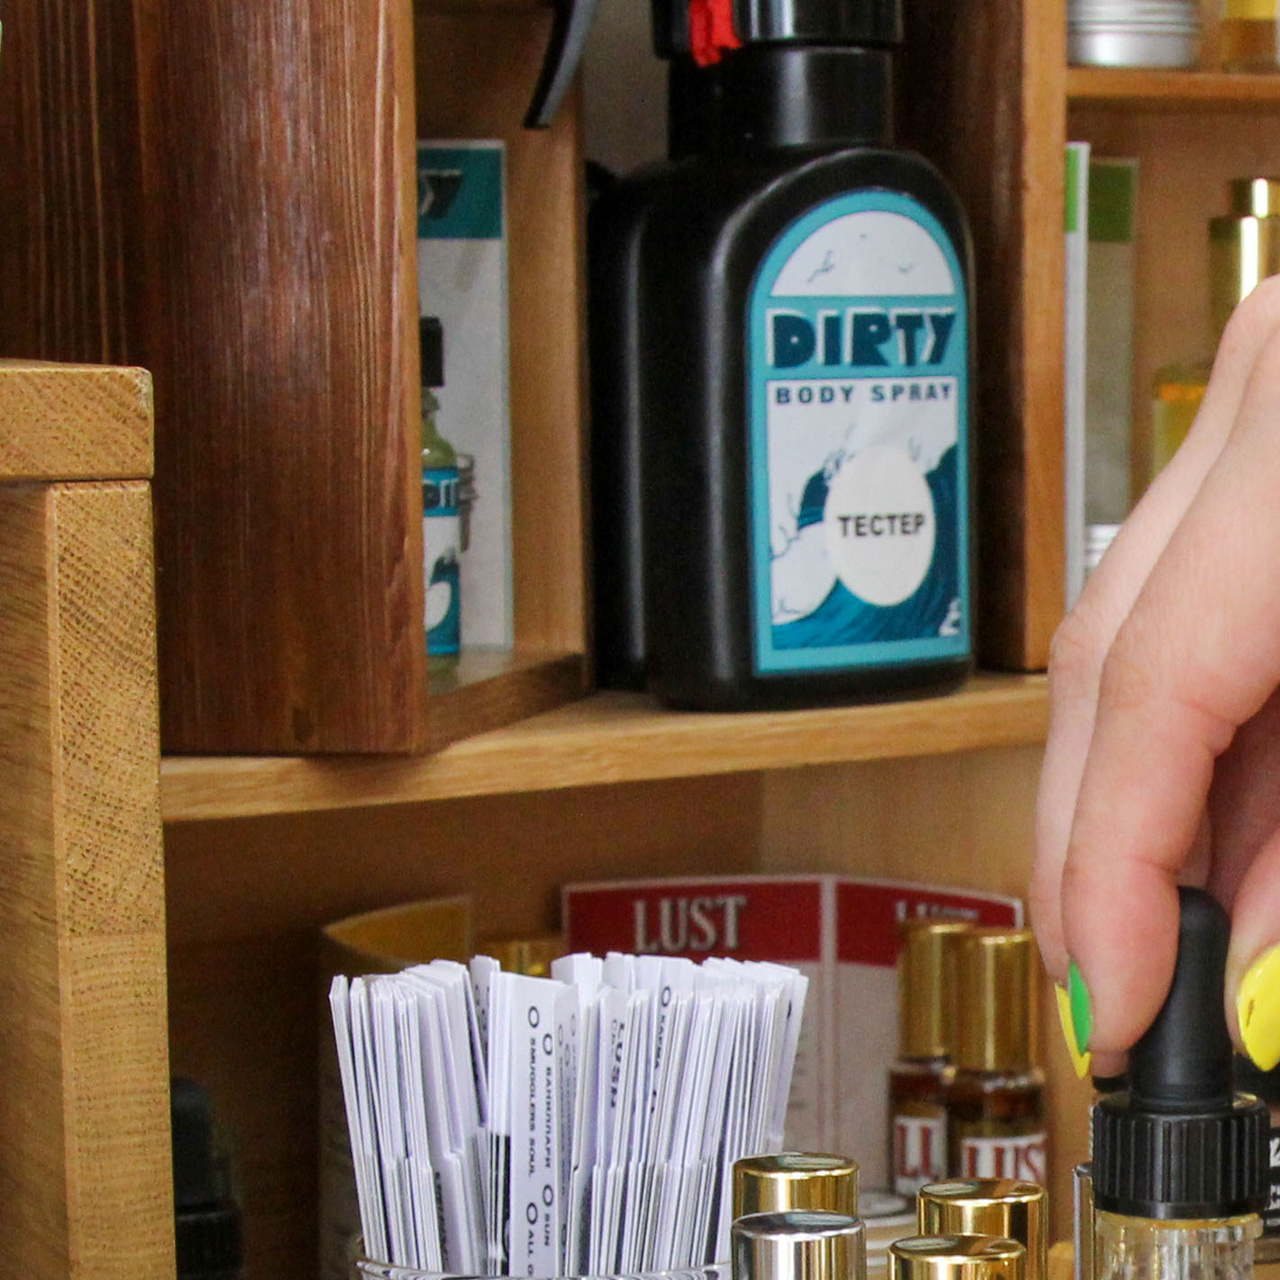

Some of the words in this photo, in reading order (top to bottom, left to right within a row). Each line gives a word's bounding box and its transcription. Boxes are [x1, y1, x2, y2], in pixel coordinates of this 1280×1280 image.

[766, 307, 957, 368] DIRTY
[775, 385, 854, 405] BODY
[871, 383, 952, 403] SPRAY
[838, 513, 925, 537] ТЕСТЕР
[634, 895, 748, 953] LUST
